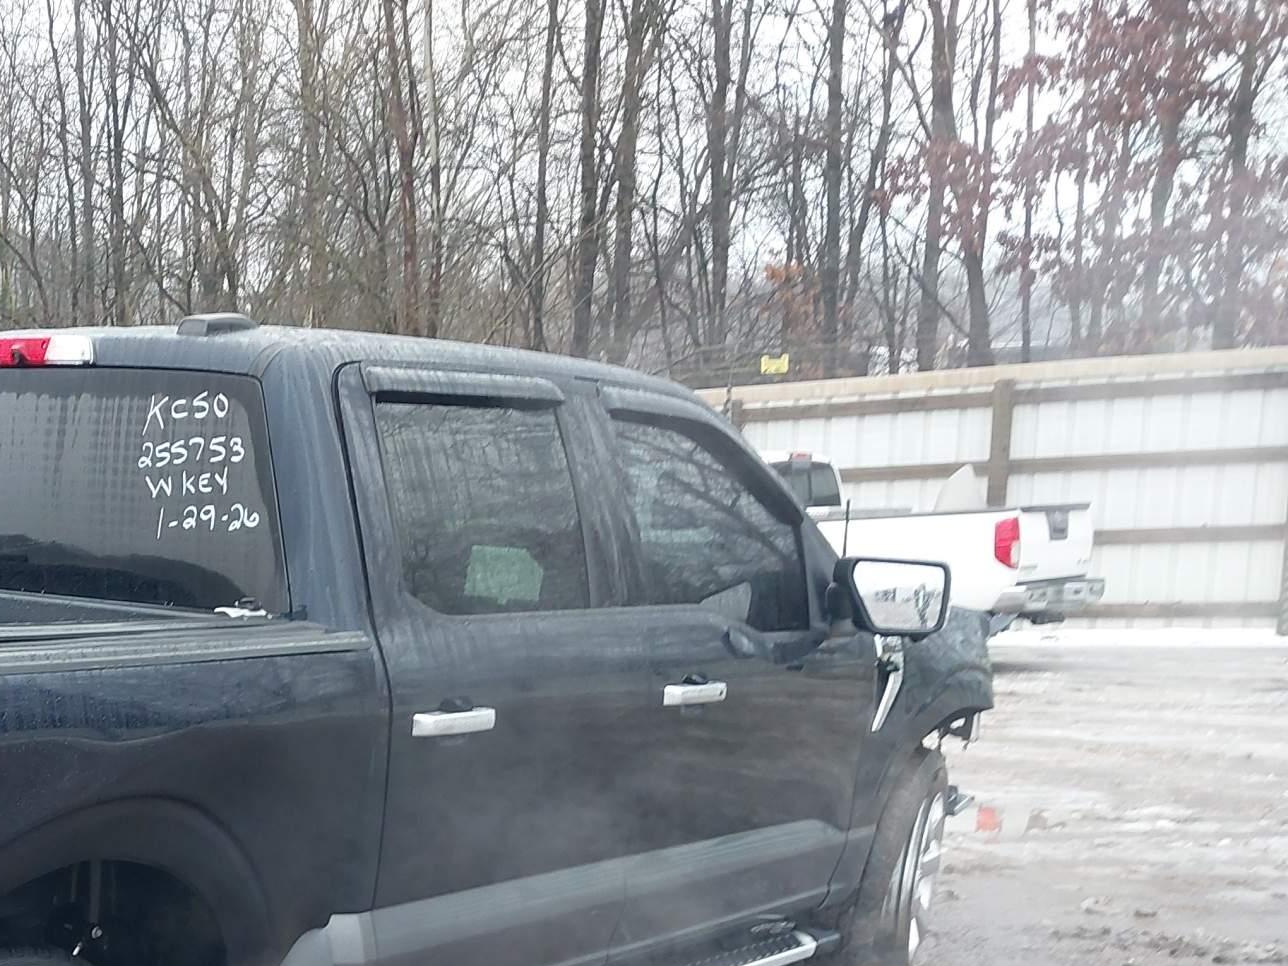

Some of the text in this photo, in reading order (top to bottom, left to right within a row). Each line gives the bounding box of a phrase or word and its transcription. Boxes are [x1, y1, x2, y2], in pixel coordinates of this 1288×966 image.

[138, 436, 245, 468] 255753
[145, 466, 228, 498] W KEY
